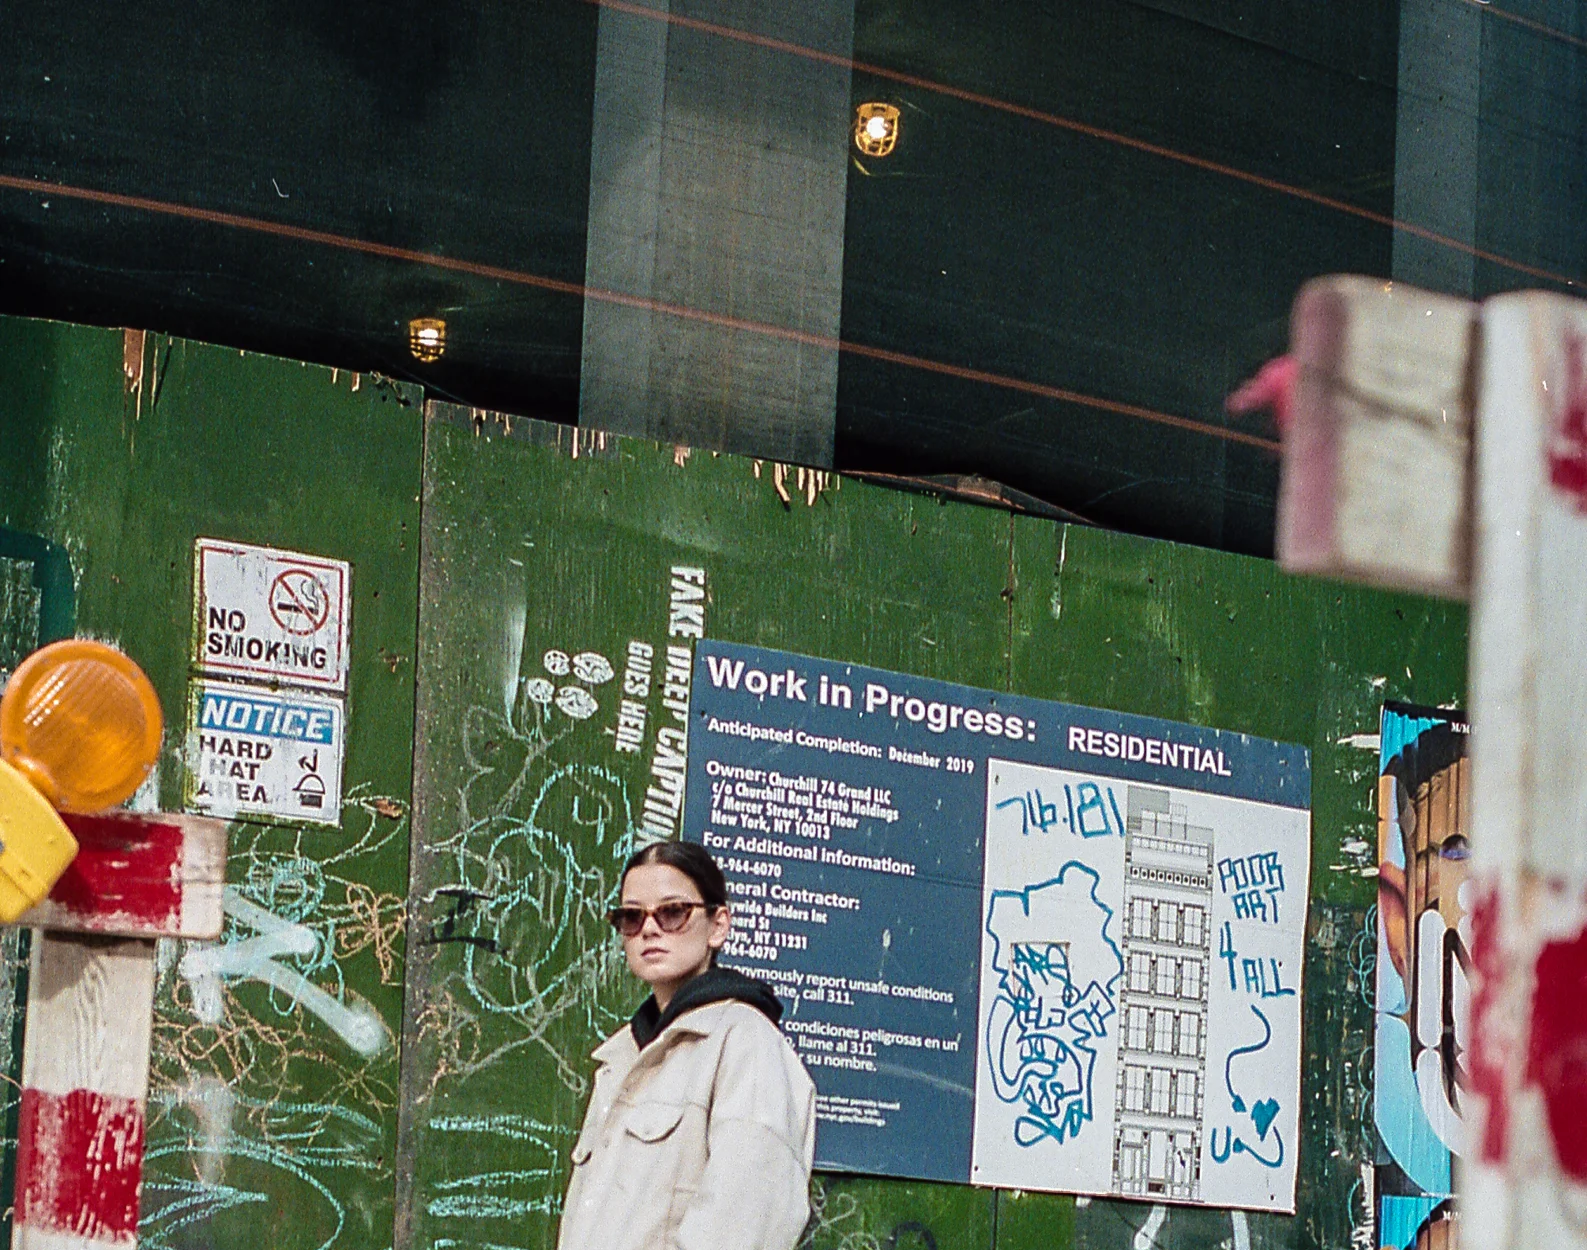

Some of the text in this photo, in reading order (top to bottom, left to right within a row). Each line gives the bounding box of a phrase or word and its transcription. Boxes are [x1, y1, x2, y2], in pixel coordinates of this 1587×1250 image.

[669, 566, 705, 639] FAKE
[209, 606, 247, 632] NO
[207, 632, 327, 669] SMOKING
[622, 640, 654, 698] GOES
[707, 654, 1037, 742] Work in Progress:
[202, 698, 326, 739] NOTICE
[199, 735, 273, 760] HARD
[707, 717, 975, 775] Anticipated Completion: December 2019
[1067, 726, 1233, 777] RESIDENTIAL
[210, 759, 260, 781] HAT
[706, 760, 892, 804] Owner: Churchill 74 Grand LLC
[712, 779, 900, 823] c/o Churchill Real Estate Holdings
[723, 796, 763, 815] Mercer
[766, 803, 803, 822] Street,
[806, 809, 828, 825] 2nd
[830, 812, 859, 829] Floor
[711, 809, 831, 840] New York, NY 10013
[703, 831, 916, 877] For Additional Information:
[1217, 851, 1285, 893] POOR
[725, 880, 861, 910] neral Contractor:
[1231, 887, 1281, 924] ART
[758, 916, 770, 930] St
[764, 902, 810, 921] Builders
[811, 908, 828, 925] Inc
[754, 930, 771, 945] NY
[773, 932, 808, 951] 11231
[802, 988, 825, 1001] call
[826, 989, 855, 1006] 311.
[806, 974, 848, 992] report
[848, 979, 890, 995] unsafe
[891, 985, 954, 1003] conditions
[785, 1020, 959, 1052] condiciones peligrosas en un
[798, 1035, 834, 1050] llame
[836, 1039, 848, 1052] al
[850, 1040, 877, 1057] 311.
[807, 1053, 878, 1072] su nombre.
